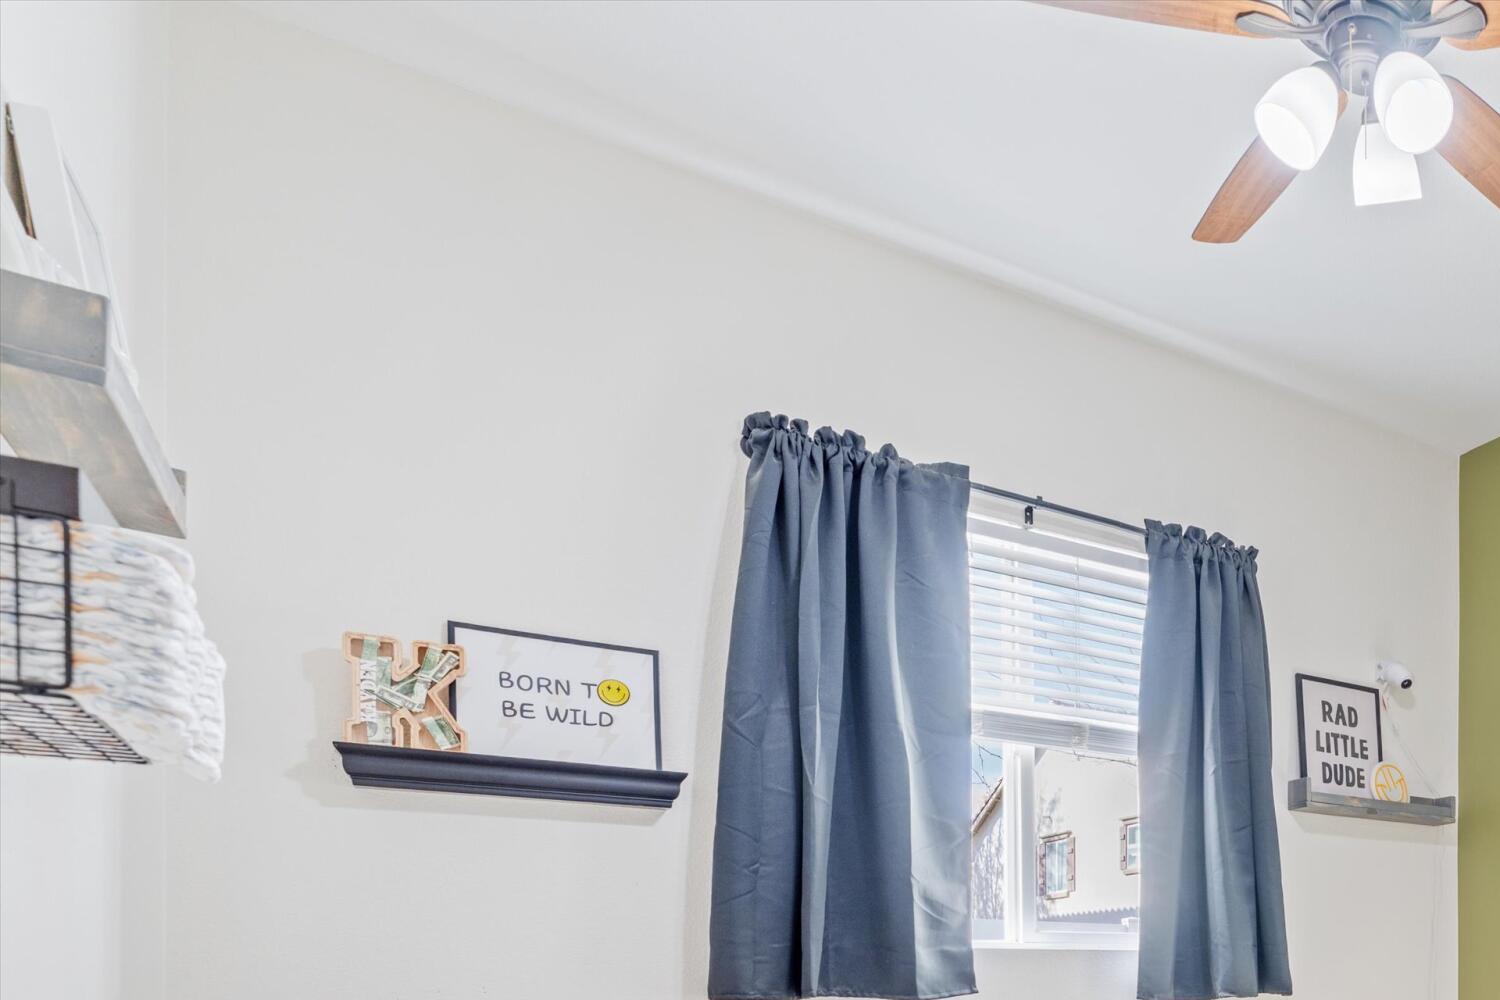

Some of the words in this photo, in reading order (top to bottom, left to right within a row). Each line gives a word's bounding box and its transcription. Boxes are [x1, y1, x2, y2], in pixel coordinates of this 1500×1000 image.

[499, 671, 570, 696] BORN
[502, 700, 536, 719] BE
[545, 705, 614, 727] WILD
[1321, 700, 1358, 728] RAD
[1315, 730, 1369, 760] LITTLE
[1322, 762, 1365, 788] DUDE
